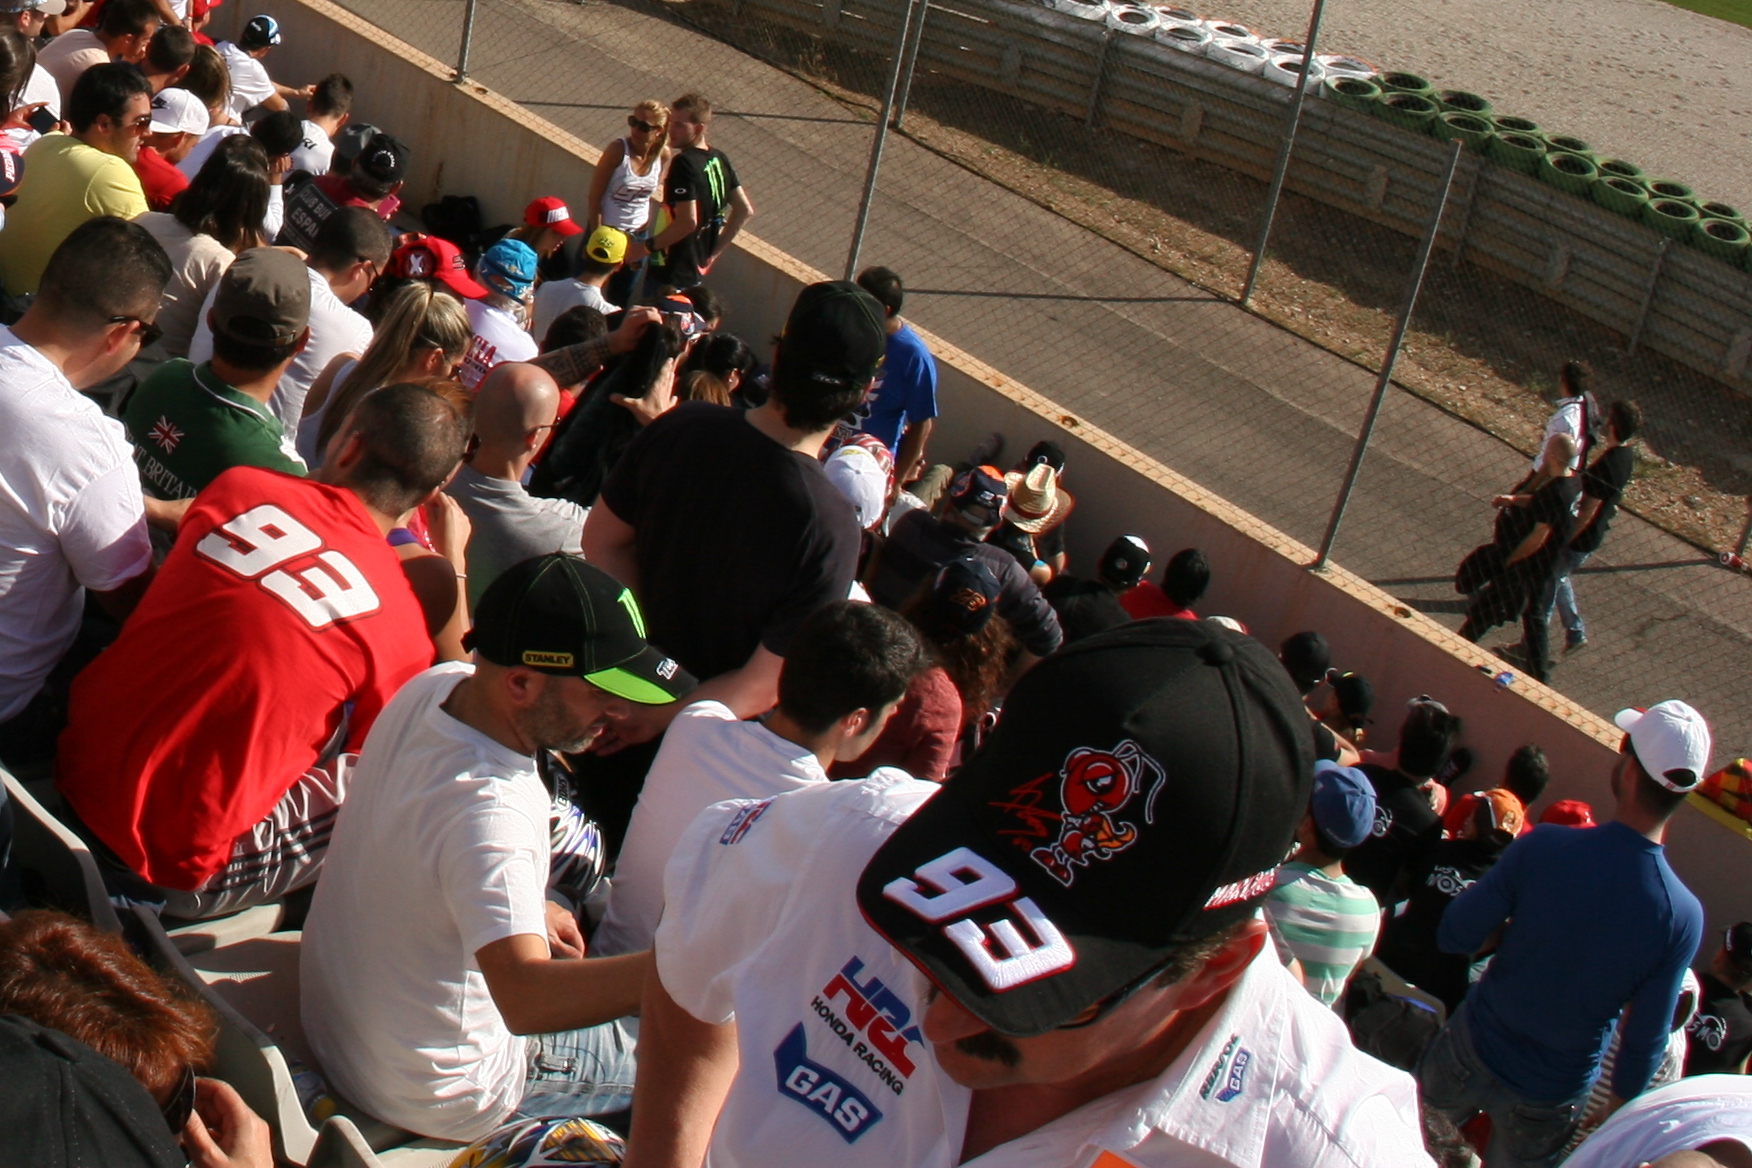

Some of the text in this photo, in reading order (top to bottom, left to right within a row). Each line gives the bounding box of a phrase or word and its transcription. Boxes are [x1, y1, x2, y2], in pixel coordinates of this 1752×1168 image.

[196, 502, 381, 628] 93
[525, 652, 570, 664] STANLEY
[883, 846, 1077, 993] 93
[811, 995, 904, 1096] HONDA RACING
[822, 955, 925, 1080] HRC
[784, 1064, 870, 1132] GAS
[1230, 1051, 1249, 1090] GAS
